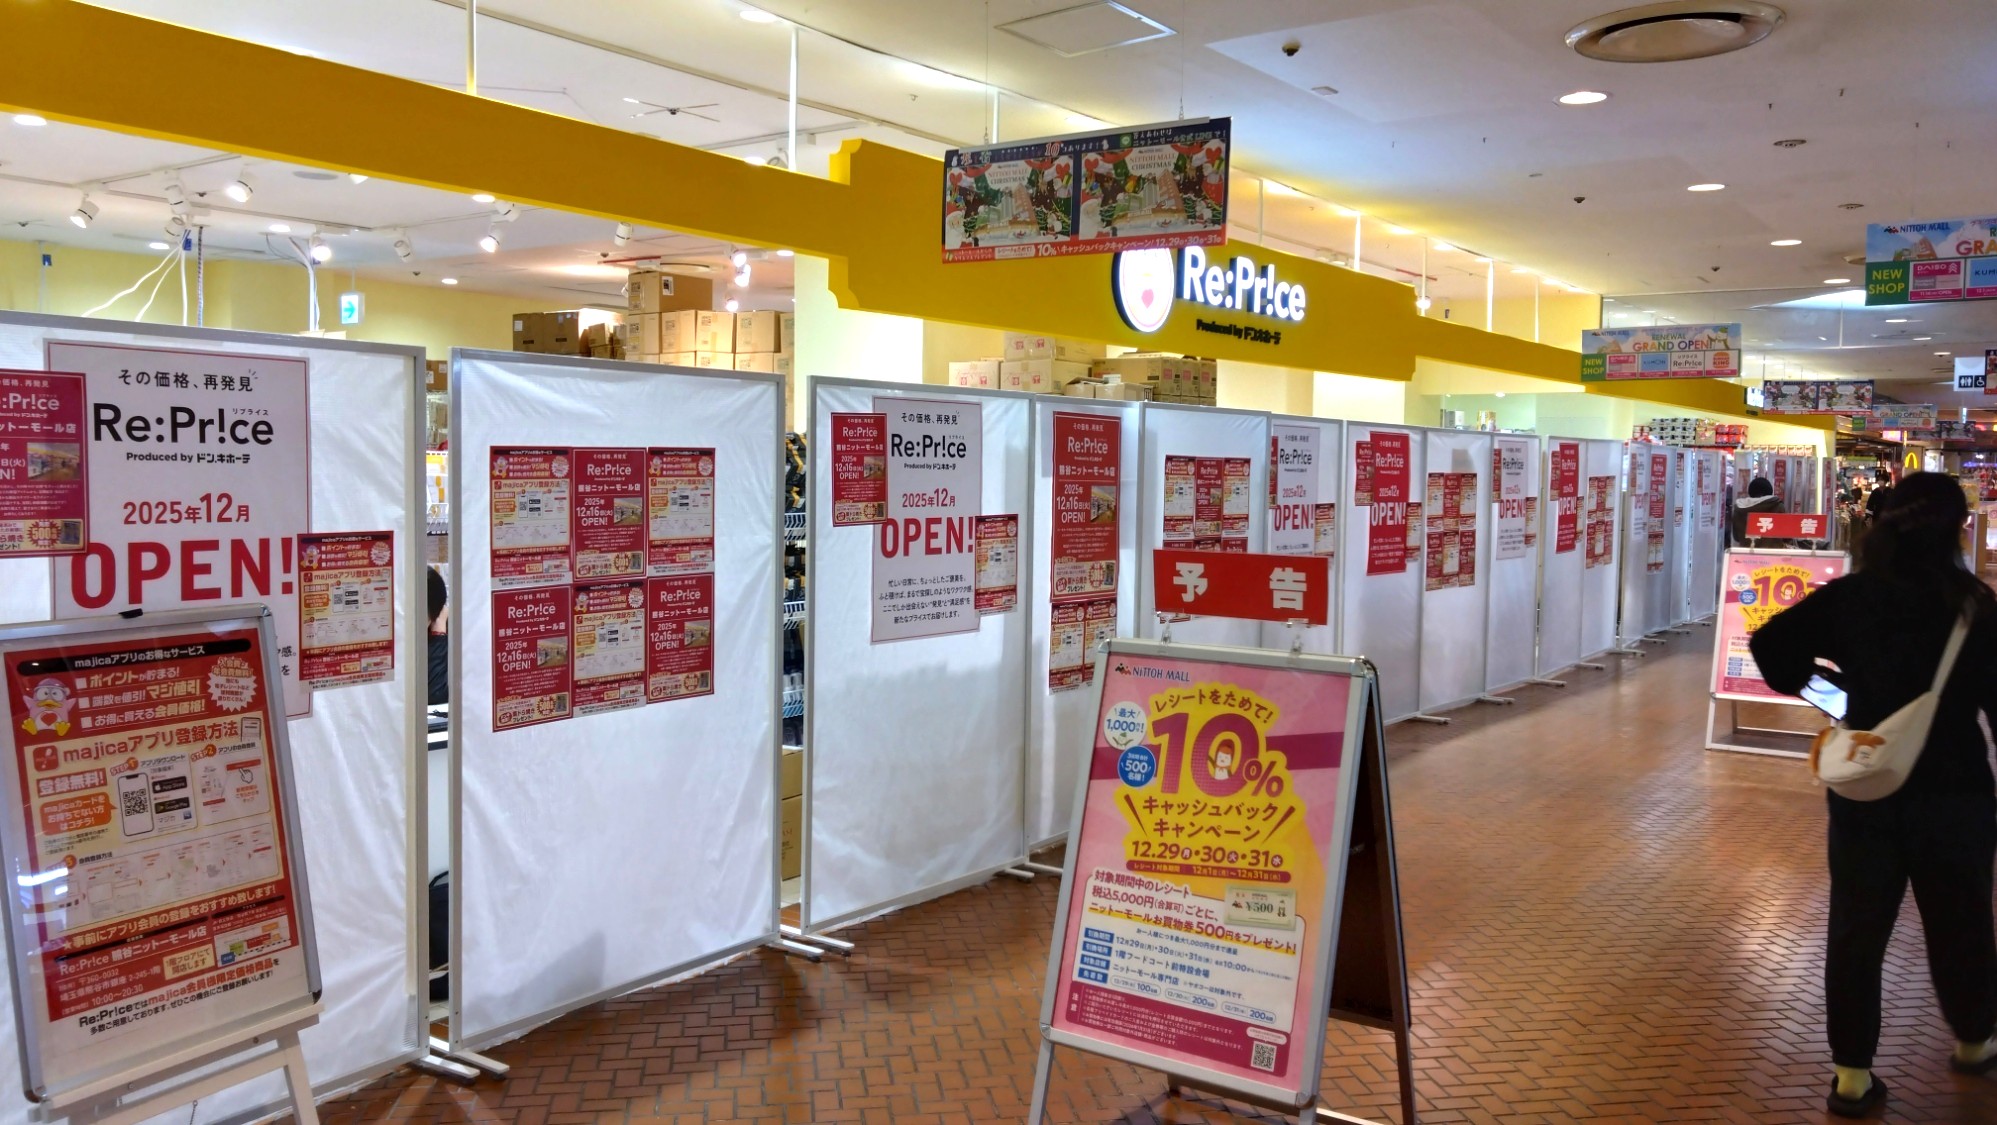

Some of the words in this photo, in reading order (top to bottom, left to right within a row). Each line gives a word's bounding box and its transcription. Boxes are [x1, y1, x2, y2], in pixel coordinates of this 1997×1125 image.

[1131, 162, 1172, 171] CHRISTMAS
[990, 176, 1025, 184] CHRISTMAS
[1872, 269, 1903, 280] NEW
[1868, 283, 1905, 294] SHOP
[1633, 341, 1674, 351] GRAND
[1678, 340, 1712, 350] OPEN!
[118, 368, 253, 392] その価格、再発見
[1583, 367, 1604, 375] SHOP
[0, 378, 49, 388] 価格、再発見
[901, 412, 958, 425] その価格、再発見
[126, 452, 177, 462] Produced
[180, 453, 193, 463] by
[902, 488, 956, 508] 2025年12月
[1064, 483, 1083, 495] 2025年
[123, 492, 250, 525] 2025年12月
[584, 498, 605, 506] 2025年
[1500, 498, 1526, 519] OPEN!
[1558, 497, 1577, 515] OPEN!
[581, 517, 608, 527] OPEN!
[1061, 511, 1086, 524] OPEN!
[1274, 503, 1314, 531] OPEN!
[1370, 502, 1406, 526] OPEN!
[1756, 517, 1818, 534] 予告
[881, 516, 973, 559] OPEN!
[71, 537, 293, 609] OPEN!
[1172, 562, 1307, 611] 予告
[657, 623, 677, 631] 2025年
[505, 641, 528, 650] 2025年
[655, 640, 680, 651] OPEN!
[74, 645, 205, 668] majicaアプリのお得なサービス
[503, 661, 531, 673] OPEN!
[1165, 670, 1190, 682] MALL
[90, 666, 180, 688] ポイントが貯まる!
[94, 699, 206, 727] お得に買える会員価格!
[1118, 708, 1136, 718] 最大
[1154, 689, 1274, 723] レシートをためて!
[63, 720, 239, 764] majicaアプリ登録方法
[1151, 712, 1284, 798] 10%
[1125, 761, 1148, 773] 500
[38, 770, 104, 796] 登録無料!
[1142, 796, 1278, 822] キャッシュバック
[1153, 818, 1261, 843] キャンペーン
[1133, 862, 1180, 873] レシート対象期間
[1094, 871, 1190, 898] 対象期間中のレシート
[1089, 901, 1297, 954] ニットーモールお買物券500円をプレゼント!
[112, 926, 207, 960] 熊谷ニットーモール店
[1113, 963, 1180, 985] ニットーモール専門店
[1115, 950, 1210, 979] 1階フードコート前特設会場
